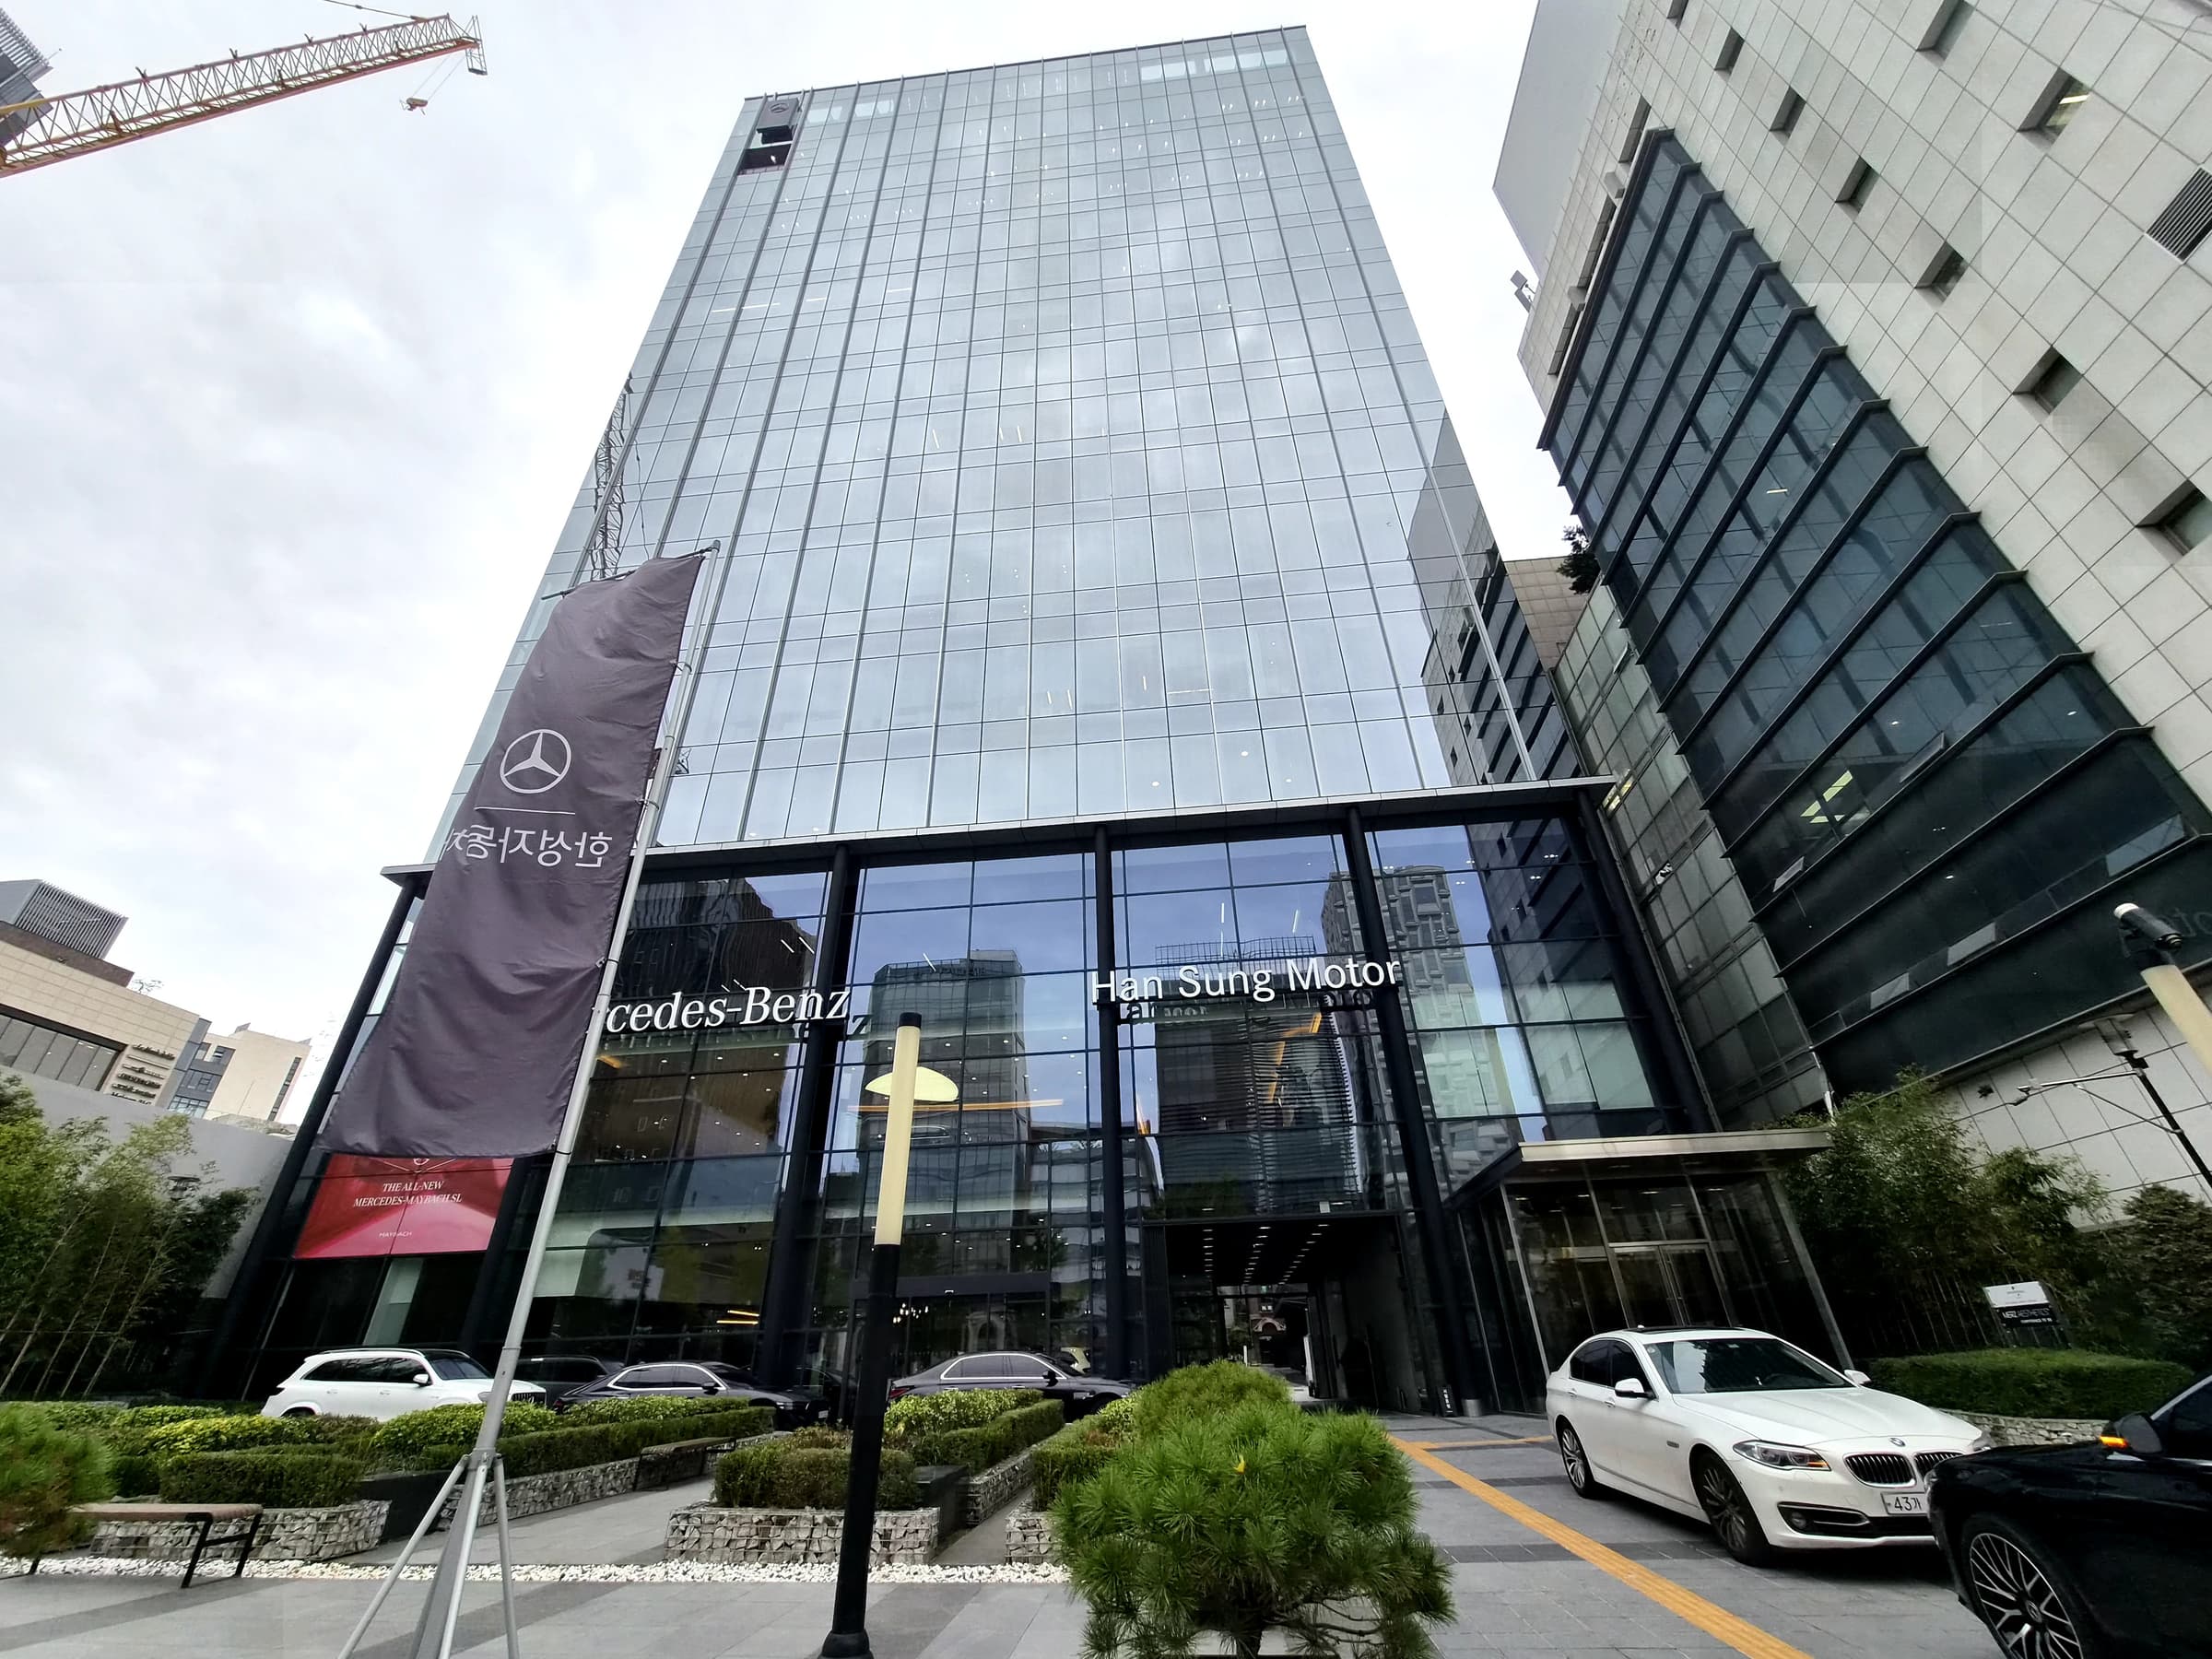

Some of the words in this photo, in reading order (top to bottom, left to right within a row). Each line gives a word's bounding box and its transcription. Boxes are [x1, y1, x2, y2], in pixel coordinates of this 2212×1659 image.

[1091, 970, 1163, 1004] Han
[1178, 964, 1277, 1003] Sung
[1286, 958, 1401, 993] Motor
[606, 986, 851, 1033] cedes-Benz
[353, 1194, 451, 1207] MERCEDES-MAYBACH
[450, 1193, 463, 1204] SL
[382, 1182, 403, 1193] THE
[403, 1181, 444, 1192] ALL-NEW
